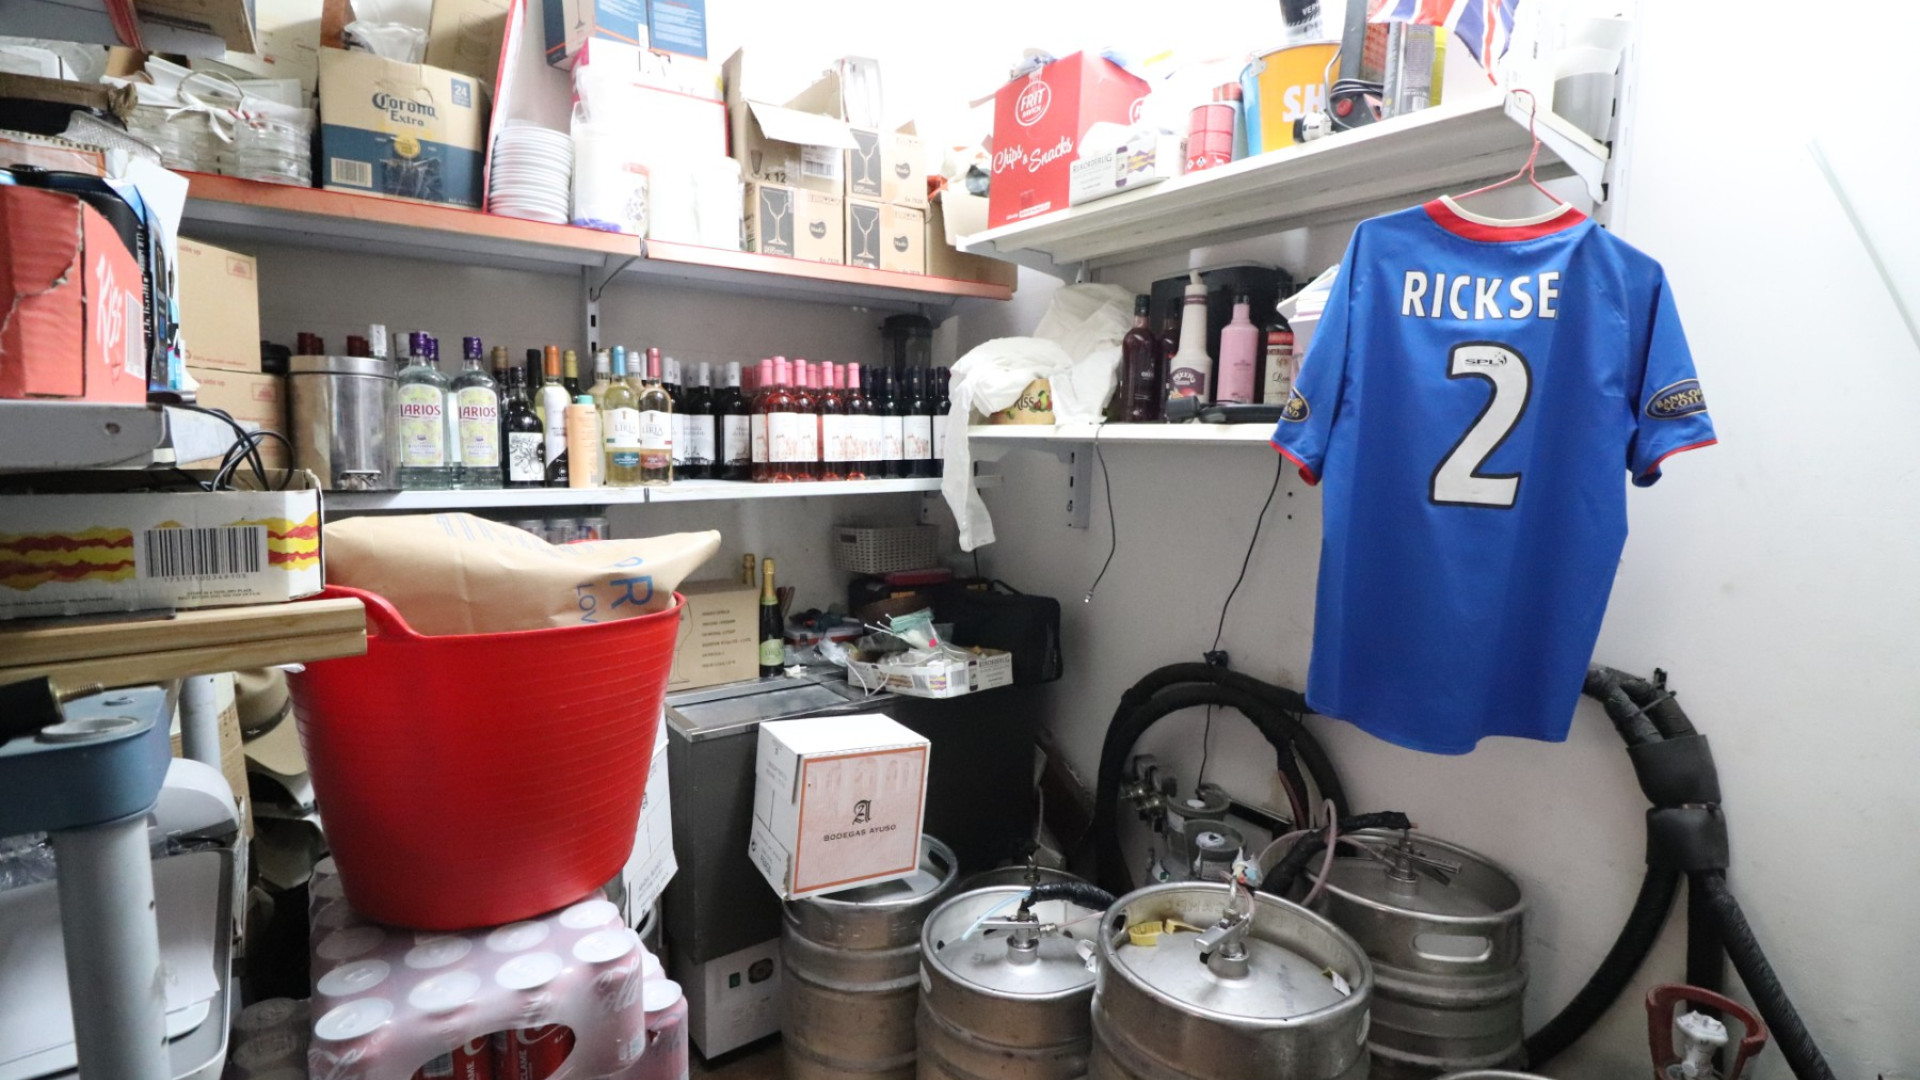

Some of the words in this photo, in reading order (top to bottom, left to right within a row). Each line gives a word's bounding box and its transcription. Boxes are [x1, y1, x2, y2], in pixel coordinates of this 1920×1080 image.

[454, 84, 467, 97] 24
[1020, 87, 1046, 111] FRIT
[372, 92, 437, 118] Corona
[390, 110, 424, 127] Extra
[993, 144, 1023, 174] Chips
[1028, 135, 1073, 173] Snacks
[774, 172, 787, 183] 12
[1402, 271, 1560, 320] RICKSE
[1655, 393, 1688, 409] BANK
[400, 403, 441, 418] LARIOS
[458, 405, 496, 421] LARIOS
[1429, 340, 1532, 509] 2
[824, 829, 866, 841] BODEGAS
[869, 824, 897, 833] AYUSO
